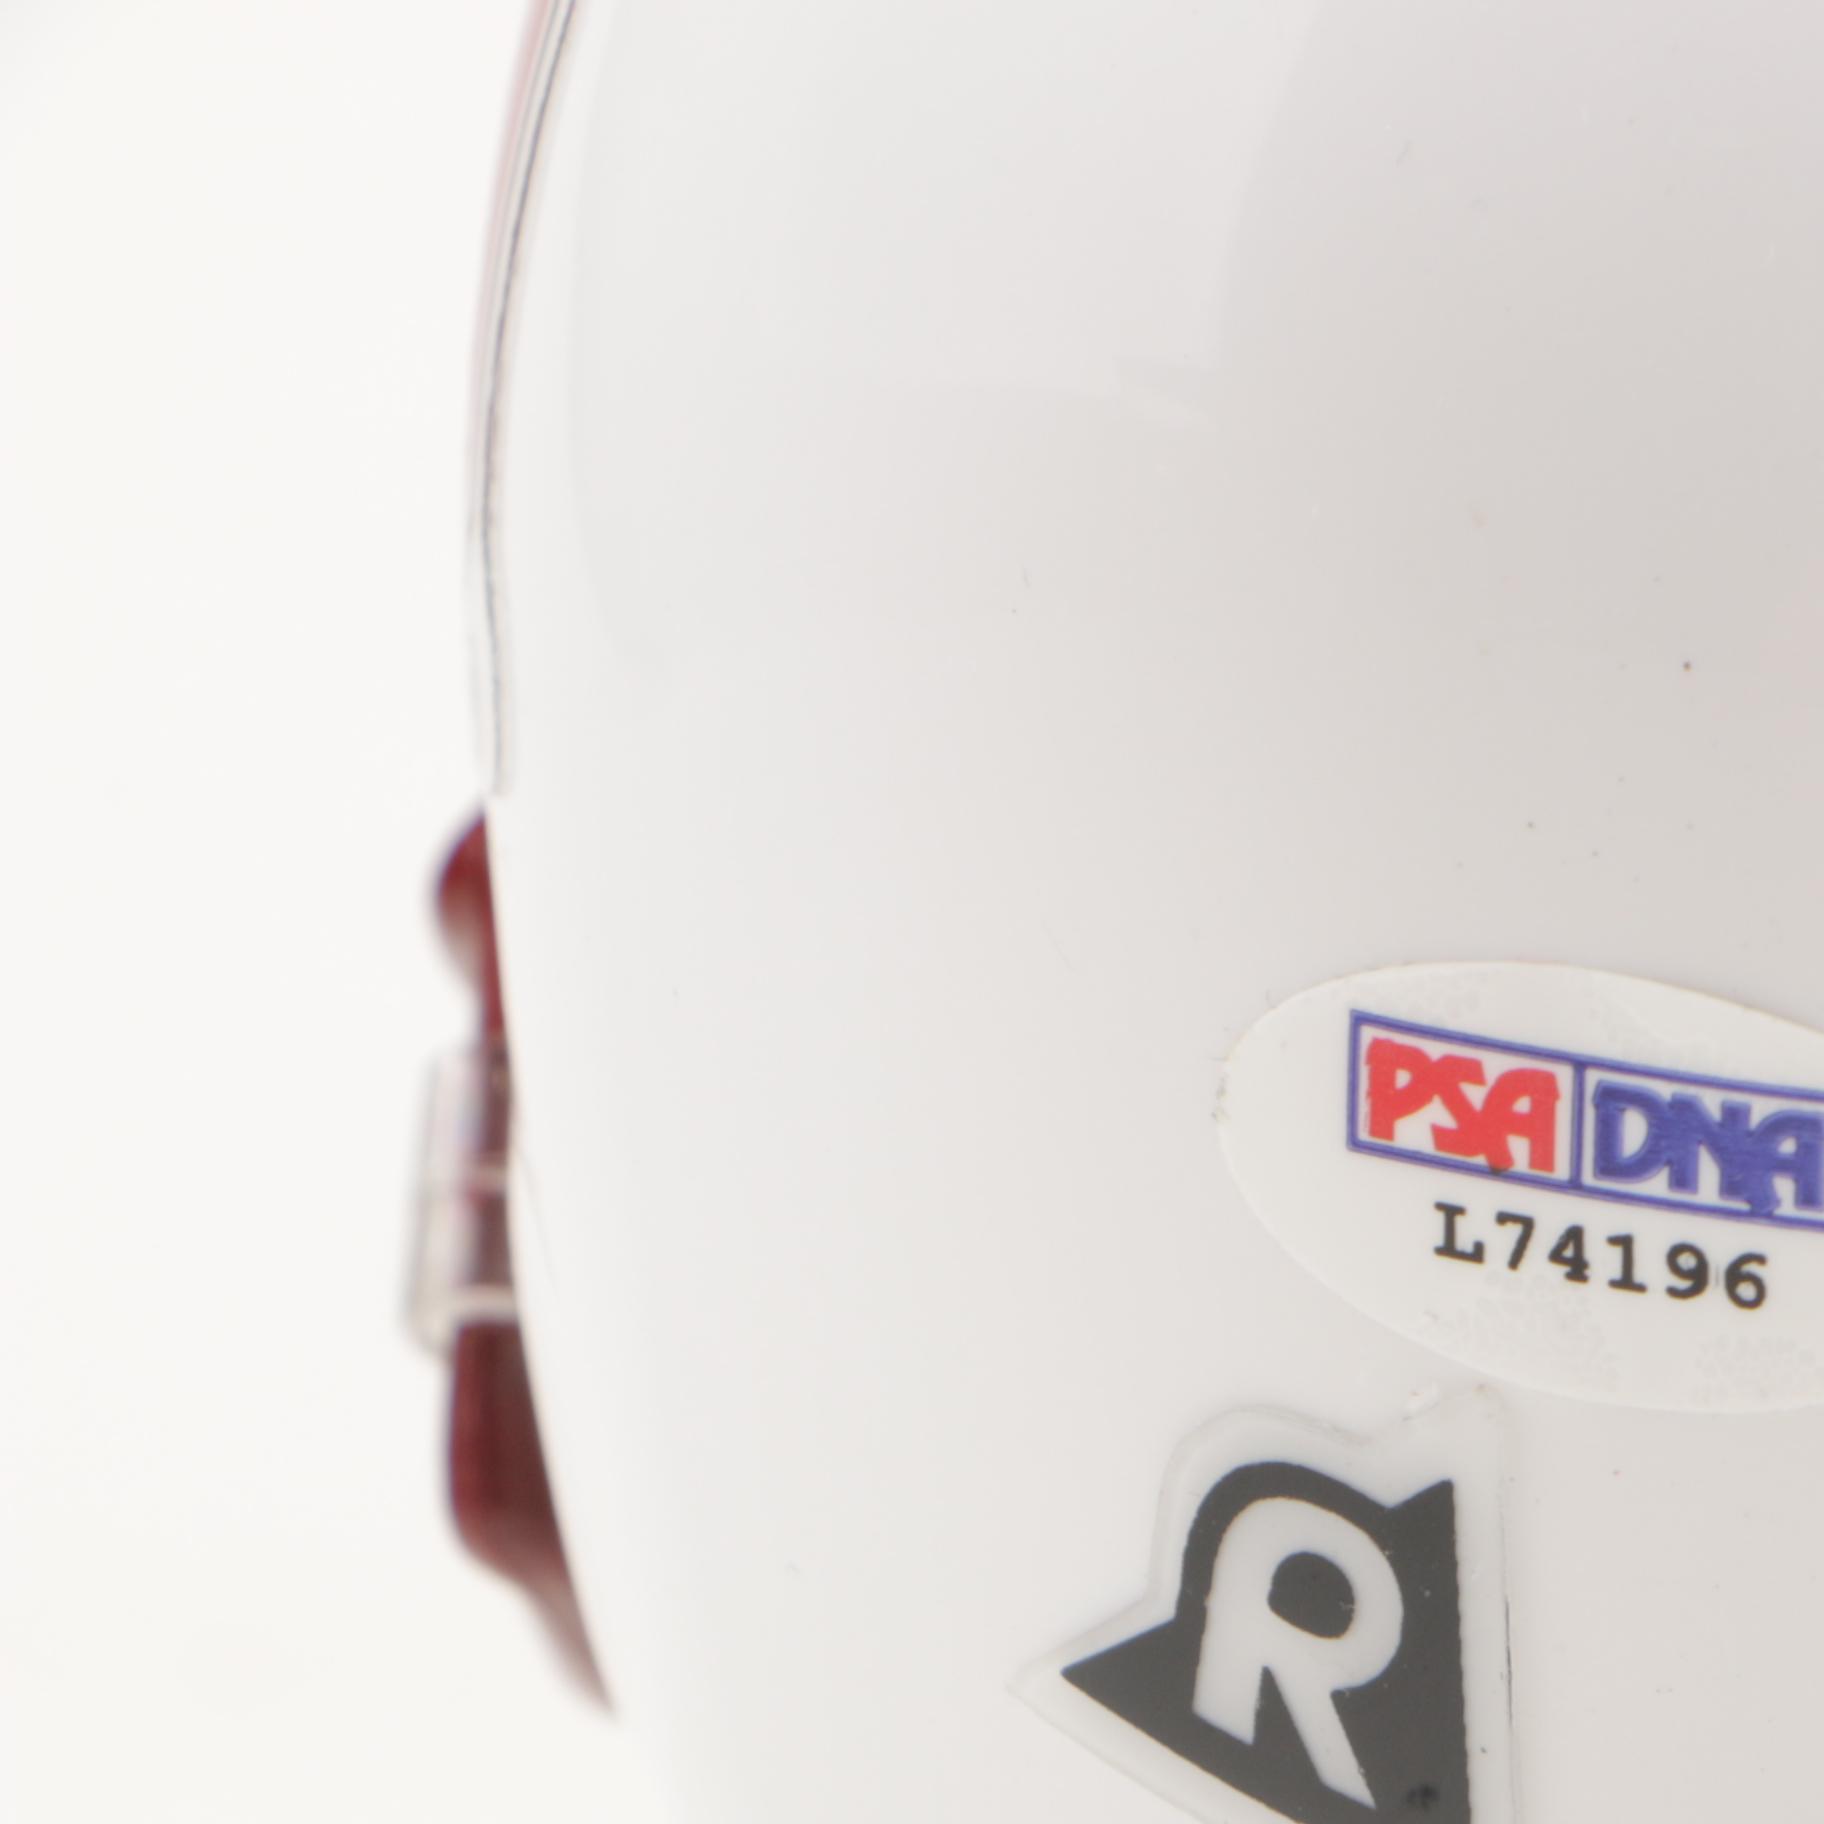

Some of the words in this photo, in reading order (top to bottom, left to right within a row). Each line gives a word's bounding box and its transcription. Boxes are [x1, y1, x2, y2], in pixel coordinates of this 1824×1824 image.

[1365, 1037, 1561, 1174] PSA
[1432, 1201, 1769, 1310] L74196
[1193, 1496, 1404, 1809] R
